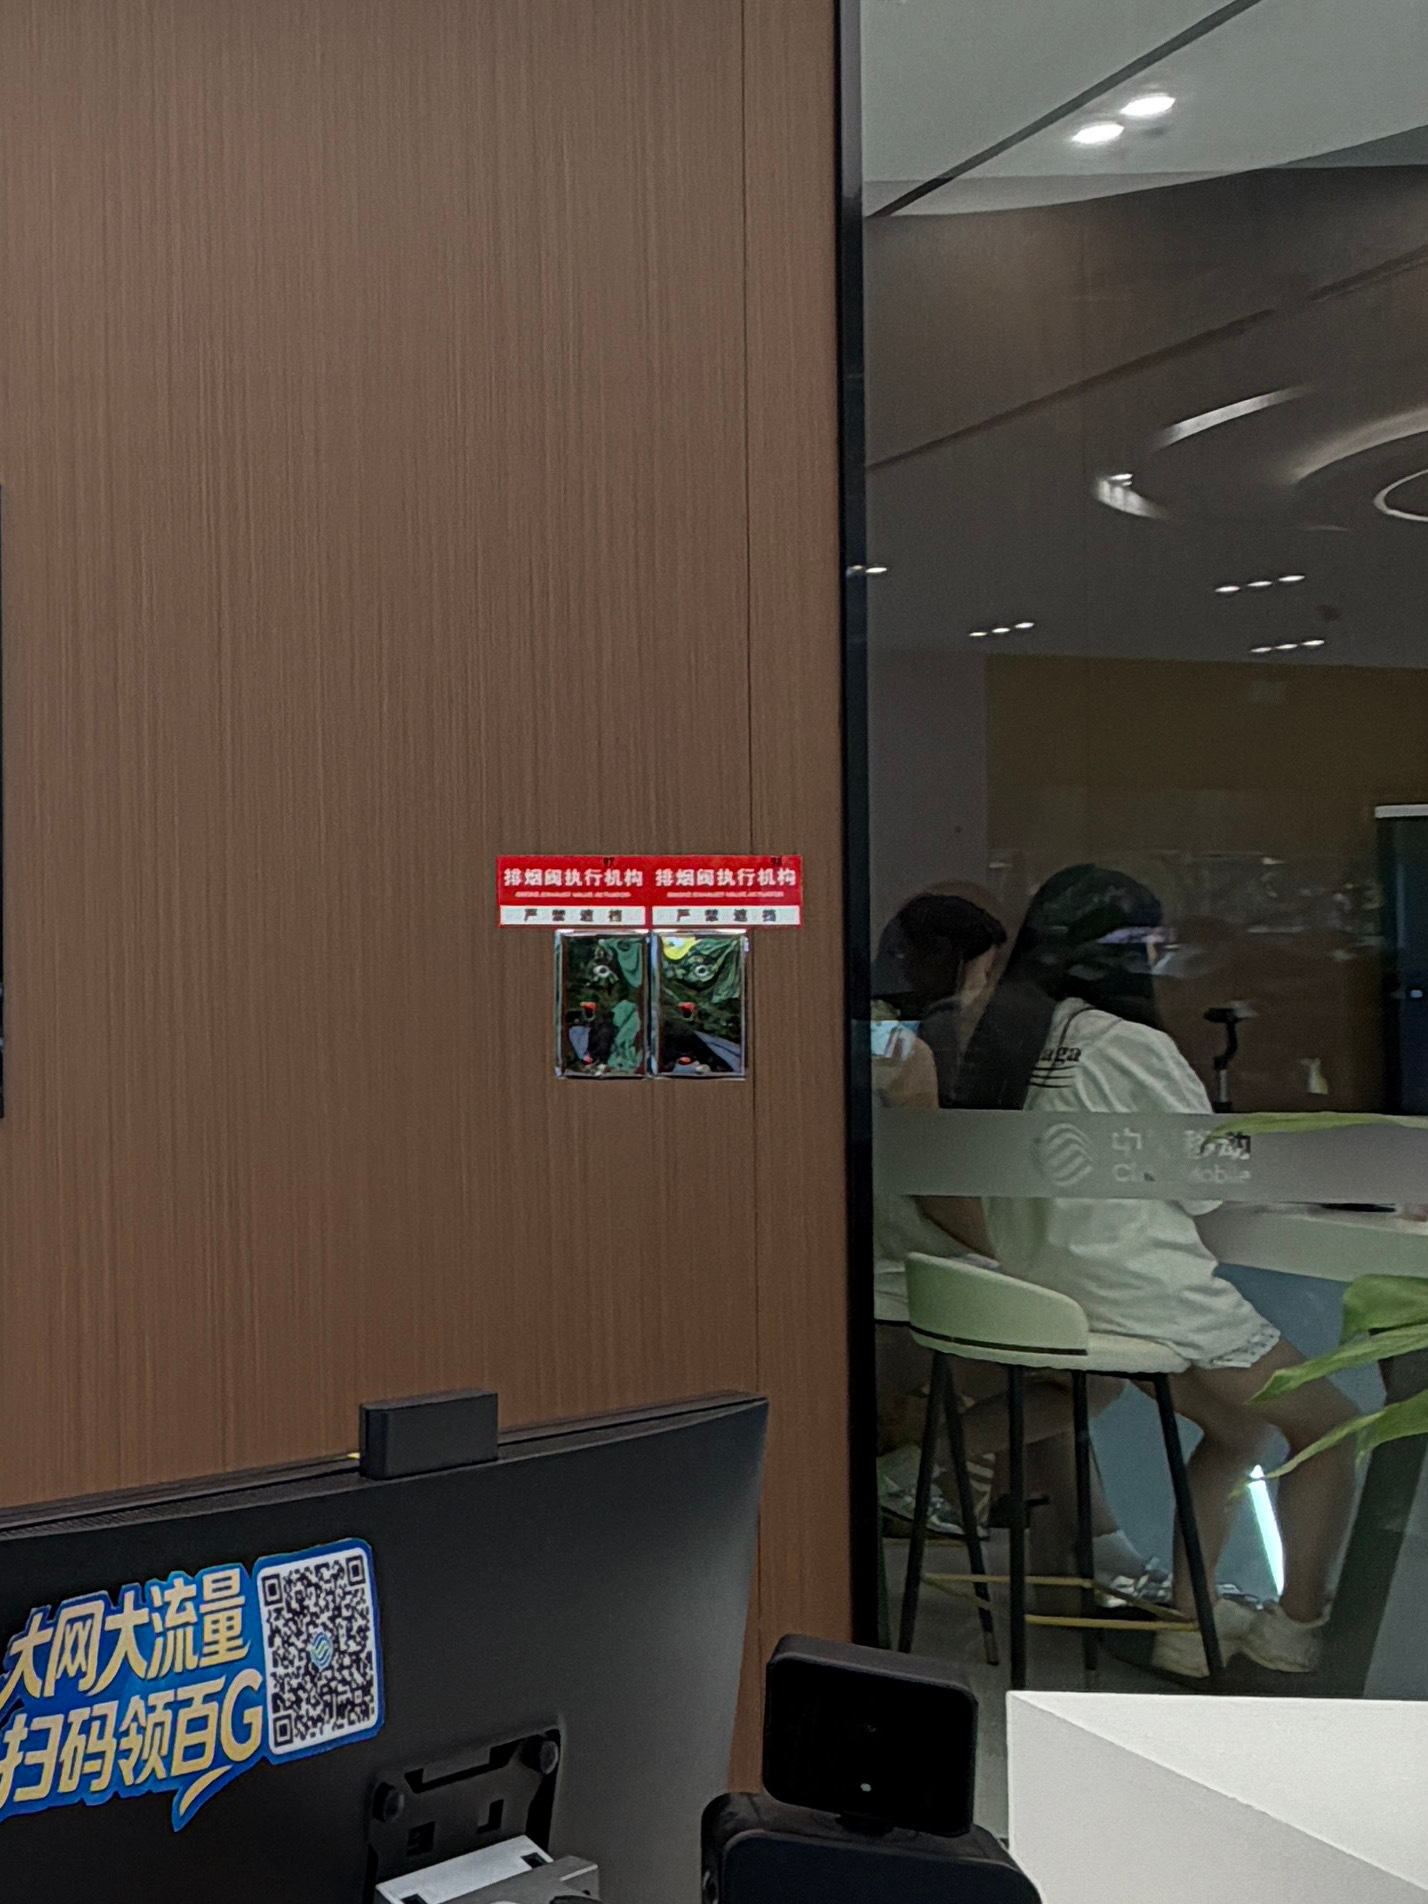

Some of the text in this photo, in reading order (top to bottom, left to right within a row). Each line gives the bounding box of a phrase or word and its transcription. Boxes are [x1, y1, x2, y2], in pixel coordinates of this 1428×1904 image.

[504, 868, 644, 887] 排烟阀执行机构
[655, 868, 797, 887] 排烟阀执行机构
